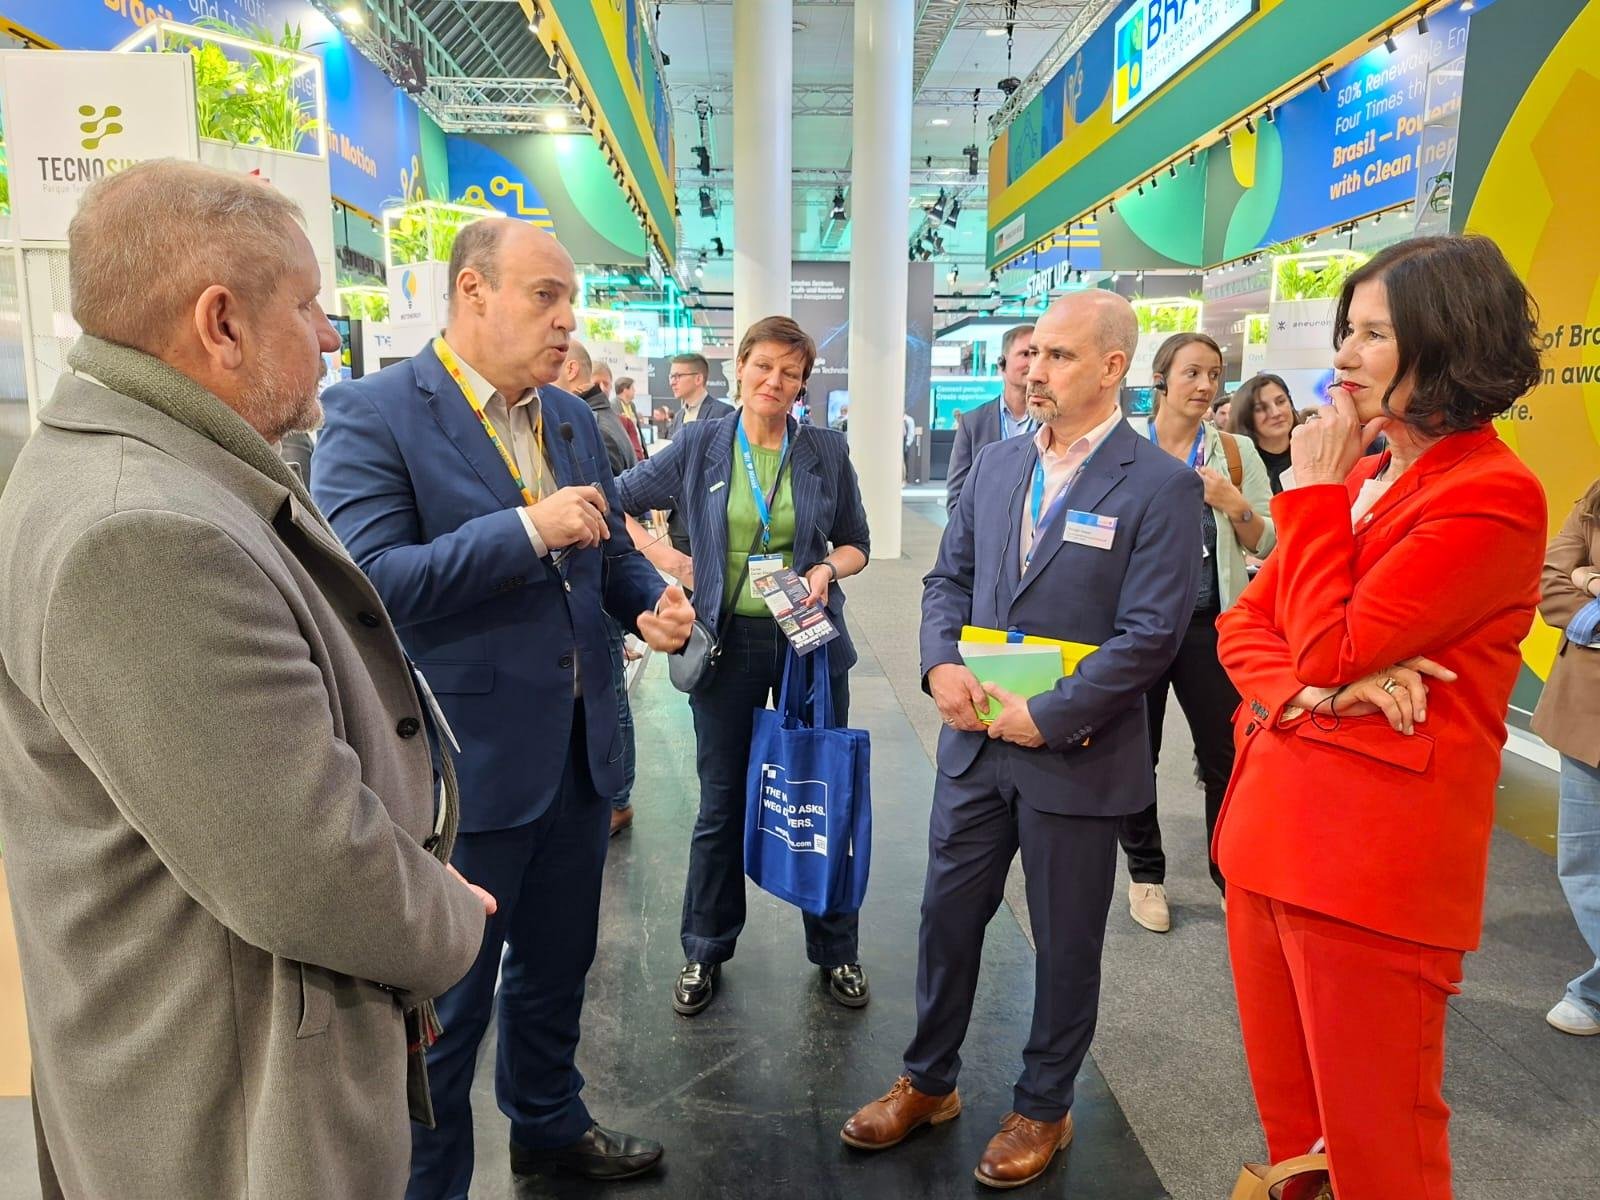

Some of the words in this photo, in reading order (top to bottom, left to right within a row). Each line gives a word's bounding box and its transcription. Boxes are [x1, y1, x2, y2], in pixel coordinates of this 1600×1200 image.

[1335, 110, 1361, 136] Four
[1365, 90, 1404, 121] Times
[1337, 80, 1362, 109] 50%
[341, 133, 377, 178] Motion
[1332, 129, 1376, 169] Brasil
[1330, 169, 1361, 200] with
[1364, 153, 1411, 188] Clean
[1027, 267, 1055, 299] START
[1054, 260, 1070, 285] UP
[1543, 325, 1564, 349] of
[764, 785, 781, 799] THE
[798, 804, 826, 817] ASKS.
